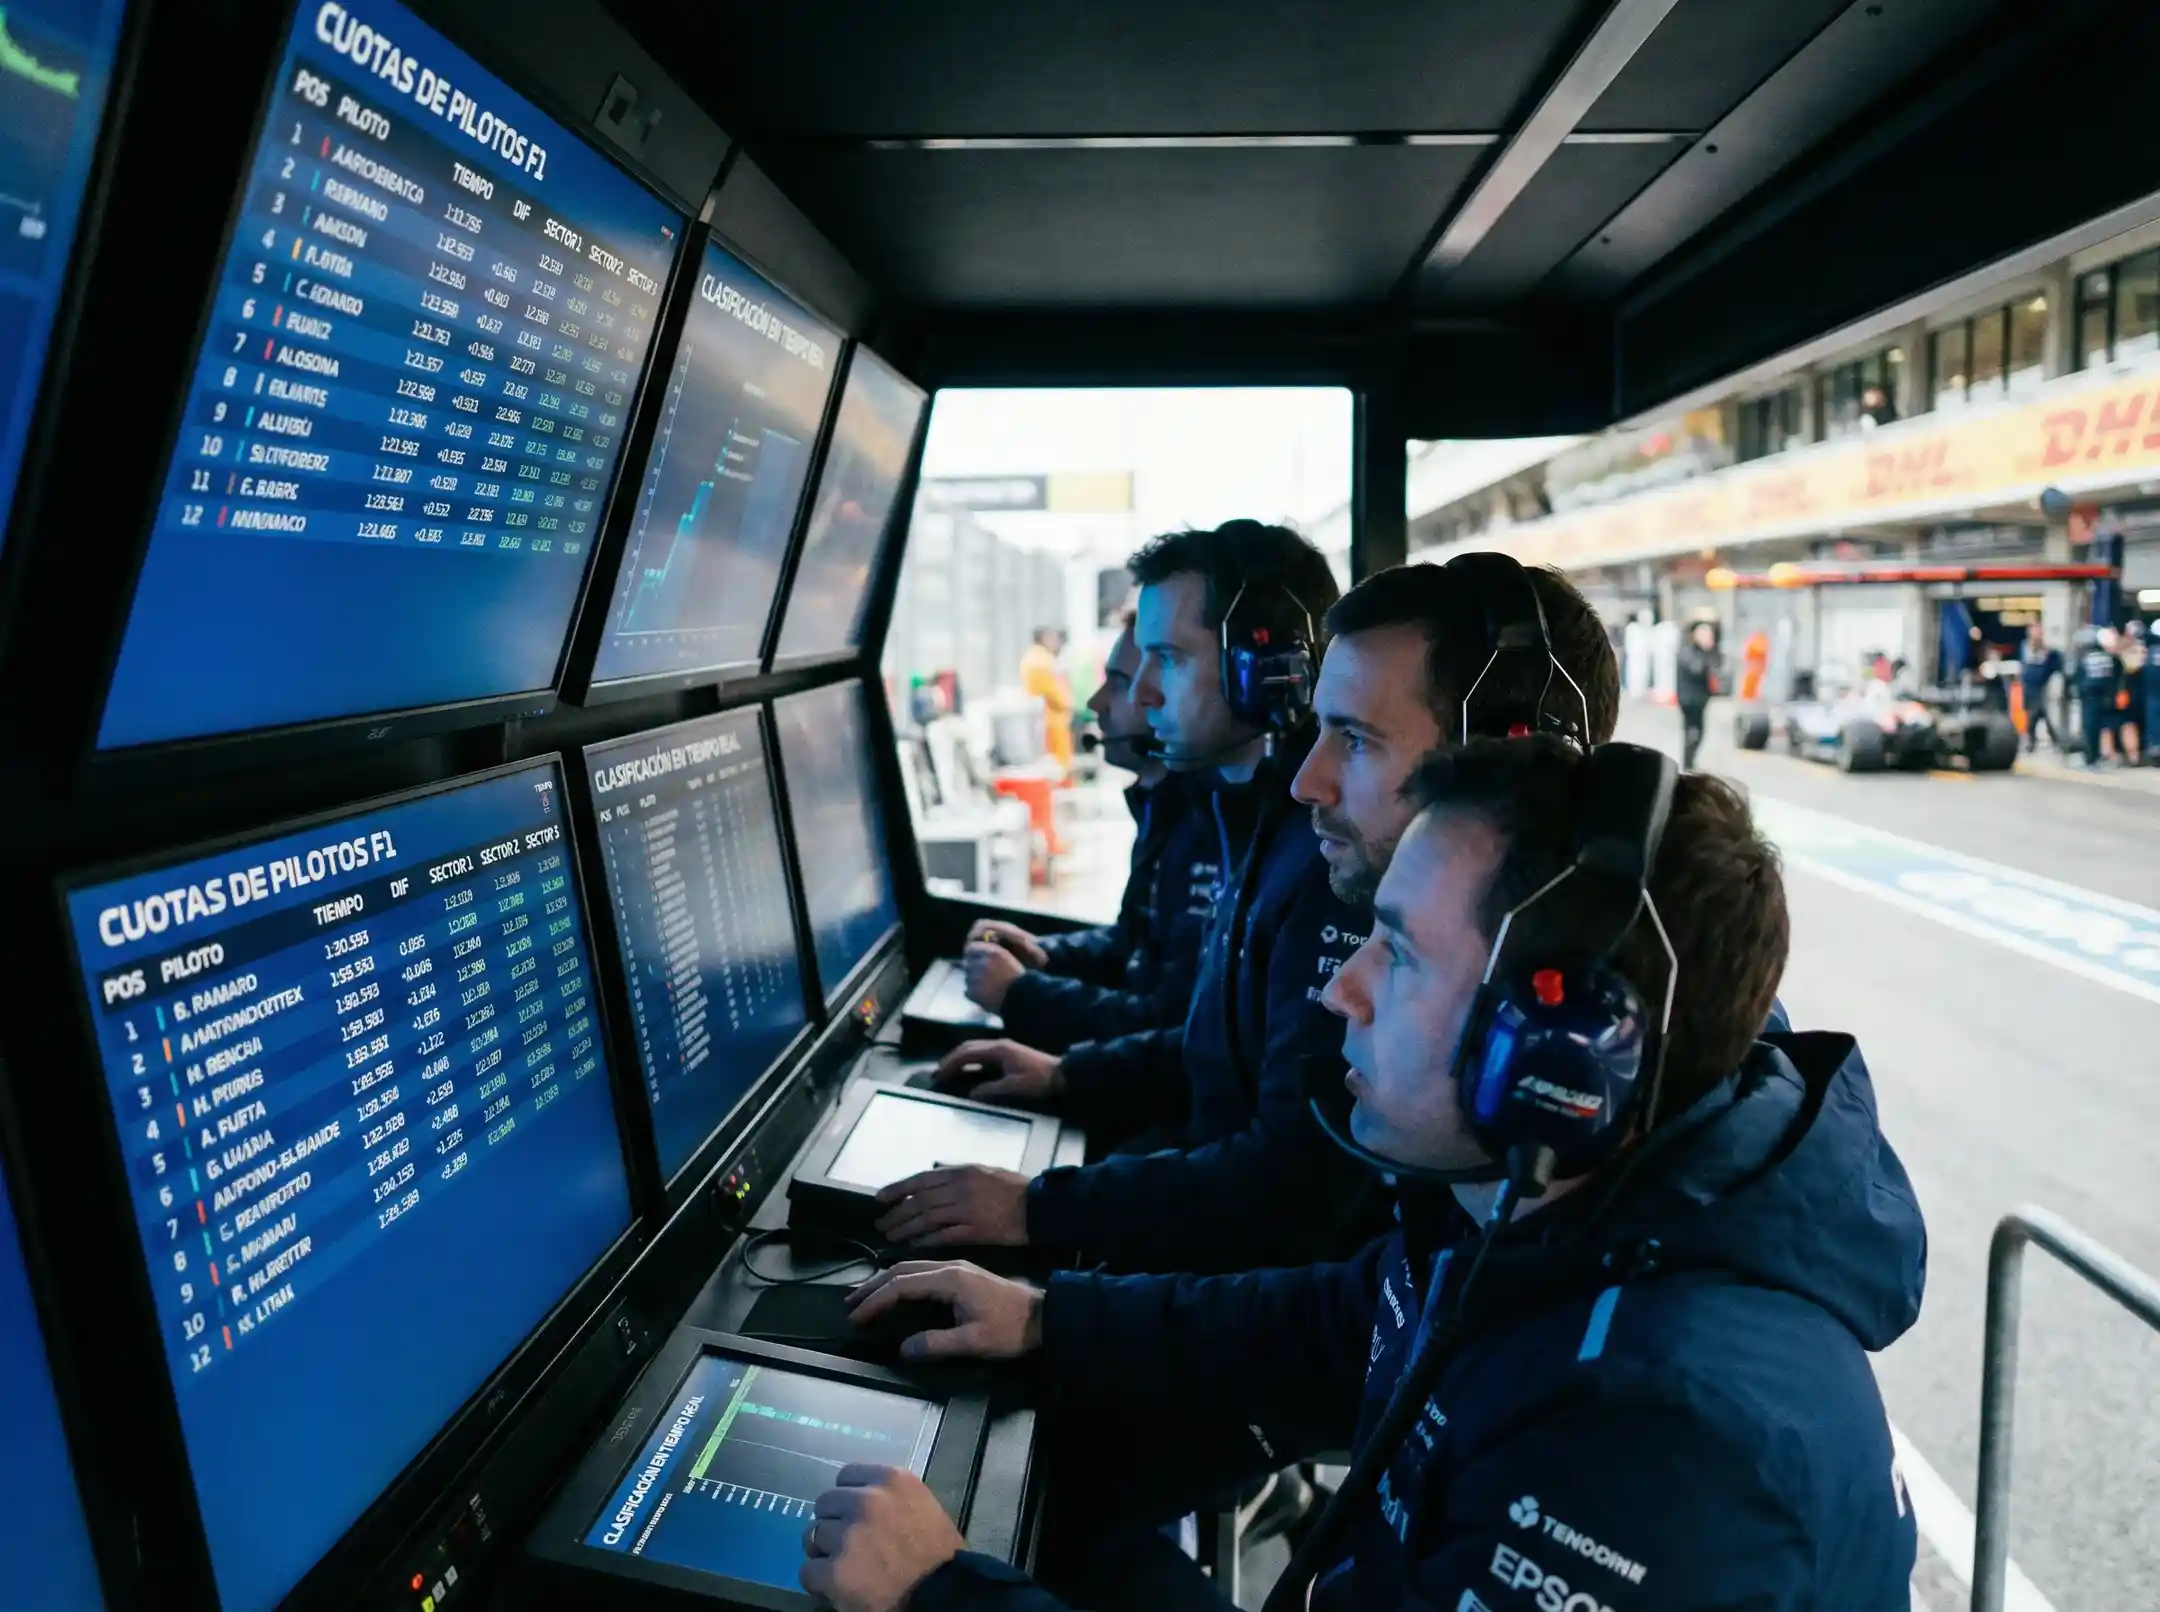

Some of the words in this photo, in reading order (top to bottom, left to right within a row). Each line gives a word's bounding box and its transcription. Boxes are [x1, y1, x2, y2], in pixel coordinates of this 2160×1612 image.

[316, 1, 418, 94] CUOTAS
[415, 68, 451, 117] DE
[447, 88, 529, 167] PILOTOS
[525, 142, 547, 181] F1
[291, 121, 302, 145] 1
[294, 70, 331, 107] POS
[337, 95, 390, 141] PILOTO
[513, 199, 532, 221] DIF
[281, 156, 295, 179] 2
[271, 192, 285, 214] 3
[262, 228, 276, 249] 4
[252, 262, 267, 284] 5
[242, 298, 256, 320] 6
[233, 332, 247, 352] 7
[223, 366, 237, 388] 8
[213, 402, 228, 422] 9
[200, 434, 223, 457] 10
[191, 469, 210, 492] 11
[181, 504, 204, 526] 12
[99, 878, 227, 947] CUOTAS
[229, 866, 269, 907] DE
[269, 837, 369, 894] PILOTOS
[370, 830, 397, 861] F1
[103, 969, 147, 1004] POS
[160, 943, 224, 983] PILOTO
[313, 894, 364, 926] TIEMPO
[390, 877, 409, 899] DIF
[124, 1020, 139, 1043] 1
[132, 1053, 146, 1075] 2
[138, 1086, 152, 1109] 3
[146, 1119, 160, 1139] 4
[152, 1153, 166, 1175] 5
[159, 1185, 173, 1208] 6
[166, 1217, 178, 1240] 7
[173, 1249, 187, 1272] 8
[180, 1282, 194, 1304] 9
[182, 1312, 206, 1341] 10
[190, 1344, 212, 1374] 12
[603, 1466, 661, 1545] CLASIFICACIÓN
[650, 1448, 671, 1468] EN
[661, 1416, 691, 1451] TIEMPO
[685, 1395, 705, 1420] REAL
